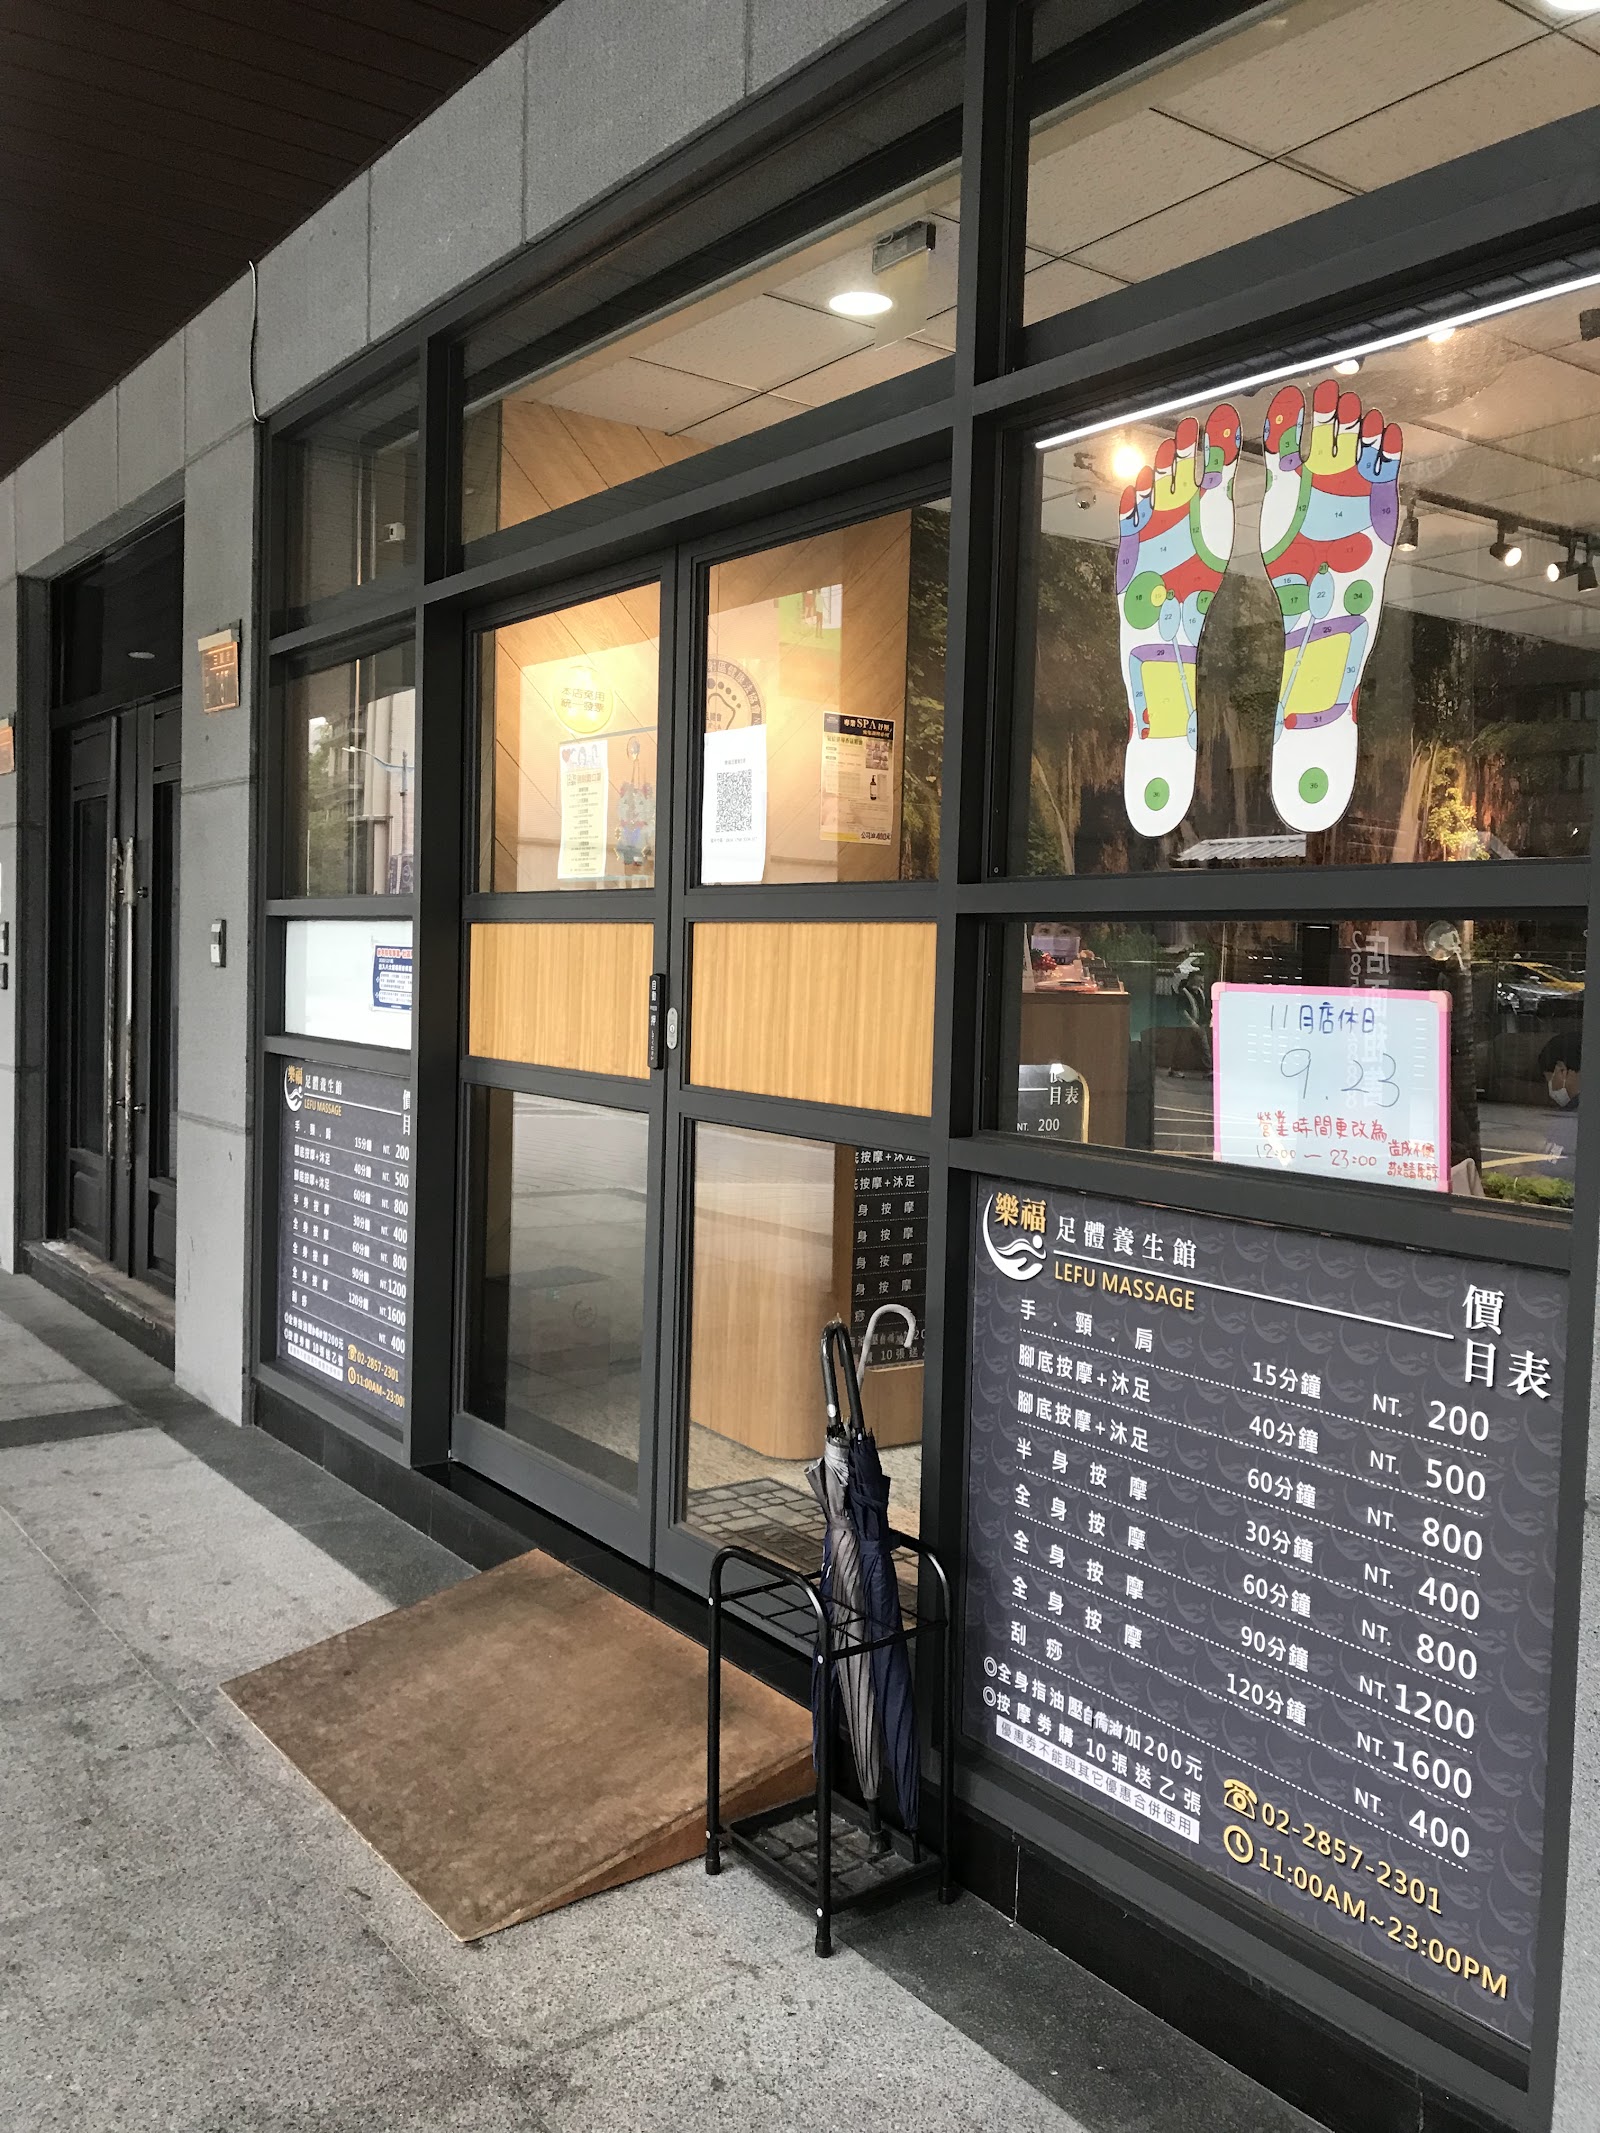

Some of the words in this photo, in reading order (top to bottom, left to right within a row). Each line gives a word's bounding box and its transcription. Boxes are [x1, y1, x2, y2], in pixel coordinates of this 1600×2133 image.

[857, 719, 876, 730] SPA
[1270, 1002, 1375, 1034] 11月店休日
[304, 1098, 316, 1110] LEFU
[317, 1101, 342, 1117] MASSAGE
[1050, 1086, 1079, 1105] 目表
[1017, 1122, 1029, 1132] NT.
[1038, 1118, 1060, 1132] 200
[1257, 1111, 1388, 1142] 營業時間更改為
[395, 1144, 409, 1160] 200
[395, 1171, 409, 1188] 500
[394, 1199, 408, 1216] 800
[994, 1192, 1047, 1233] 樂福
[393, 1226, 407, 1243] 400
[1056, 1216, 1197, 1268] 足體養生館
[393, 1253, 407, 1271] 800
[387, 1279, 406, 1299] 1200
[1055, 1261, 1096, 1287] LEFU
[1102, 1272, 1195, 1311] MASSAGE
[387, 1306, 405, 1326] 1600
[391, 1335, 405, 1353] 400
[356, 1351, 399, 1382] 02-2857-2301
[1252, 1361, 1322, 1400] 15分鐘
[1373, 1394, 1402, 1418] NT.
[1428, 1400, 1489, 1441] 200
[1018, 1343, 1151, 1403] 腳底按摩+沐足
[1249, 1415, 1319, 1455] 40分鐘
[1370, 1450, 1399, 1475] NT.
[1425, 1458, 1486, 1501] 500
[1017, 1390, 1149, 1453] 腳底按摩+沐足
[1247, 1468, 1316, 1510] 60分鐘
[1367, 1506, 1396, 1532] NT.
[1422, 1516, 1482, 1561] 800
[1016, 1437, 1148, 1501] 半身按摩
[1245, 1520, 1314, 1564] 30分鐘
[1364, 1563, 1394, 1589] NT.
[1418, 1576, 1480, 1621] 400
[1015, 1483, 1146, 1551] 全身按摩
[1243, 1573, 1311, 1619] 60分鐘
[1361, 1619, 1391, 1646] NT.
[1416, 1633, 1477, 1680] 800
[1013, 1529, 1145, 1600] 全身按摩
[1241, 1625, 1309, 1673] 90分鐘
[1359, 1675, 1388, 1703] NT.
[1395, 1683, 1475, 1740] 1200
[1012, 1575, 1142, 1649] 全身按摩
[1226, 1673, 1306, 1727] 120分鐘
[1356, 1731, 1386, 1760] NT.
[1393, 1740, 1472, 1799] 1600
[1010, 1621, 1063, 1661] 刮痧
[1355, 1787, 1384, 1817] NT.
[1408, 1809, 1470, 1858] 400
[1261, 1803, 1442, 1915] 02-2857-2301
[1258, 1848, 1508, 1999] 11:00AM~23:00PM
